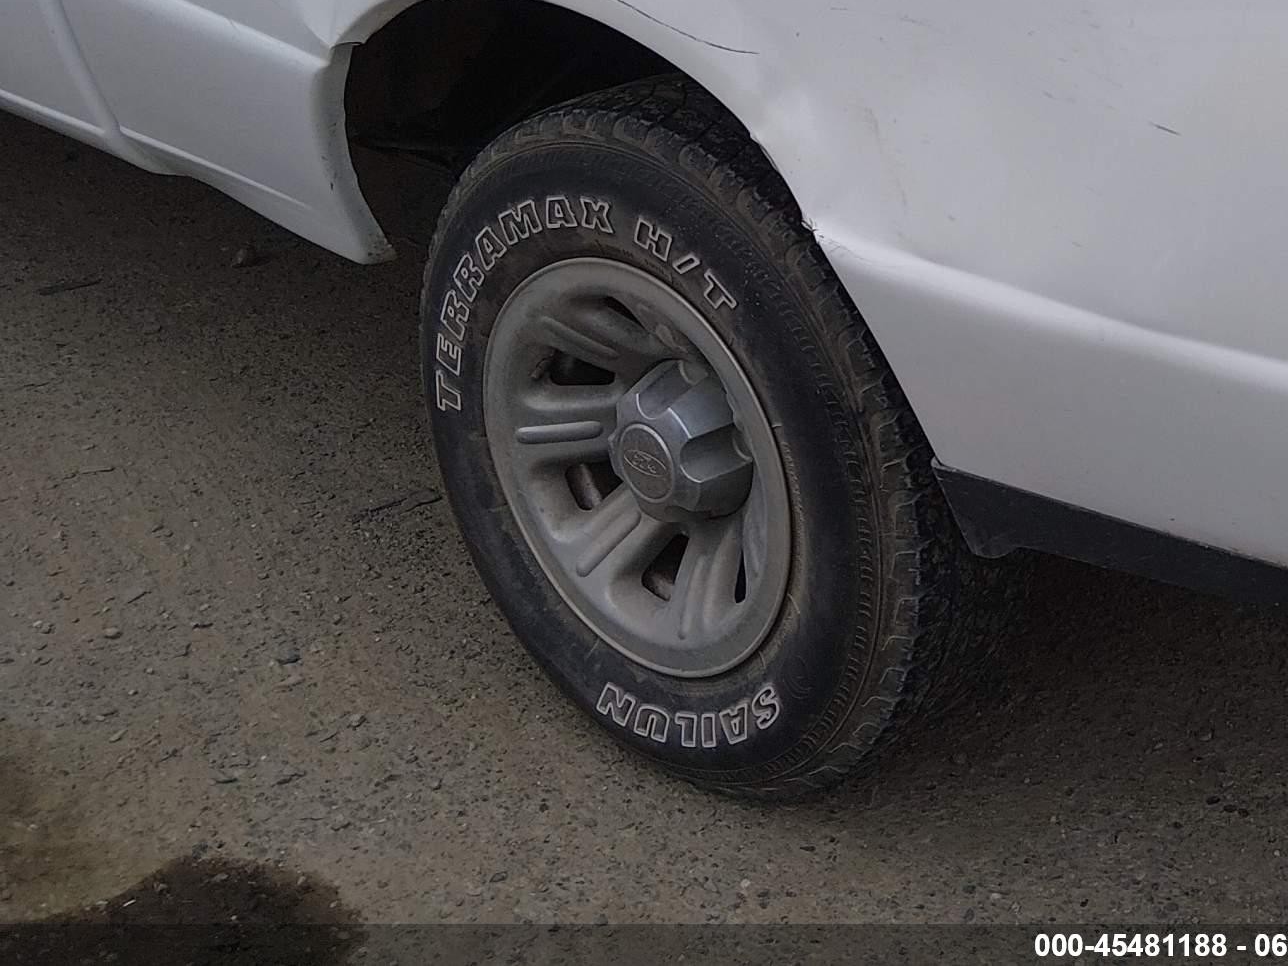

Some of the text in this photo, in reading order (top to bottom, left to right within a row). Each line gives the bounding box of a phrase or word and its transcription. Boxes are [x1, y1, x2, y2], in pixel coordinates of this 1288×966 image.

[435, 196, 738, 412] TERRAMAX H/T
[596, 682, 780, 747] SAILUN
